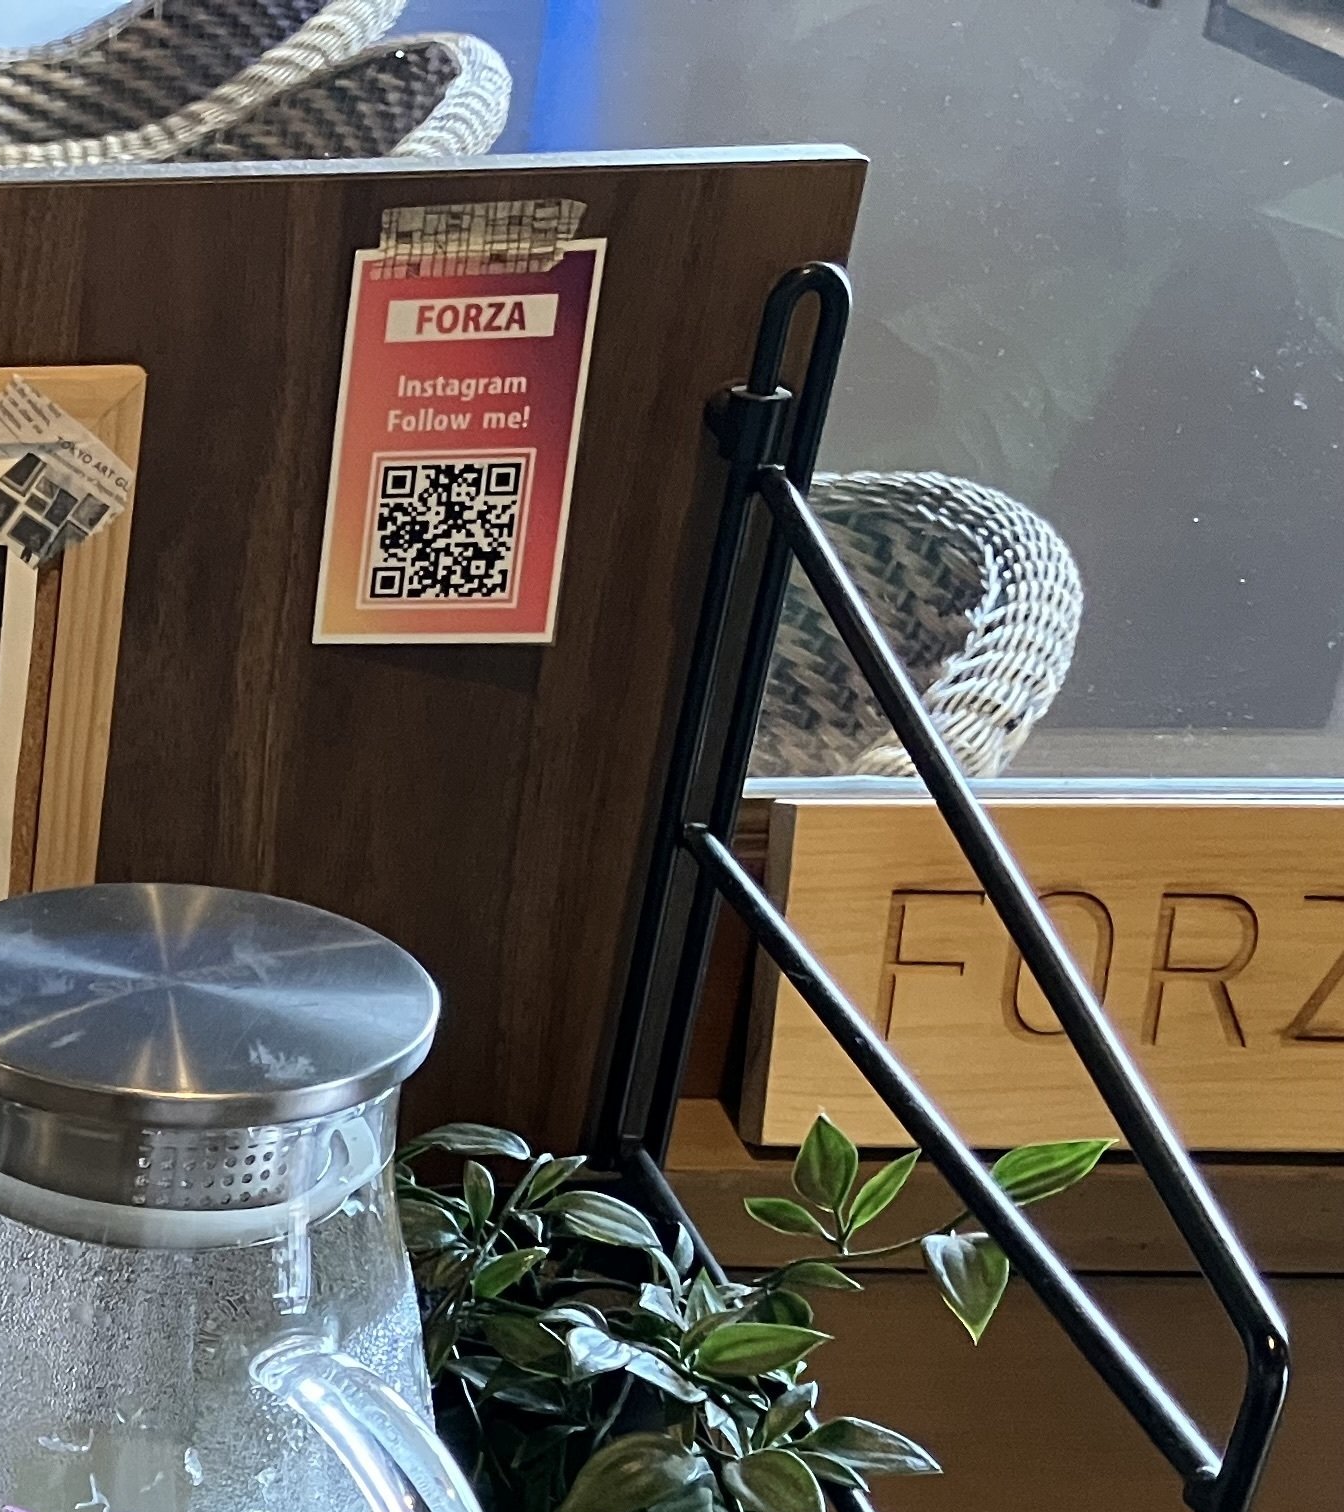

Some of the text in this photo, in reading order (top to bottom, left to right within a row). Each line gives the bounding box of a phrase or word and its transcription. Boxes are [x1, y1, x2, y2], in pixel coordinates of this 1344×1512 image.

[415, 301, 526, 335] FORZA
[398, 375, 527, 399] Instagram
[387, 405, 531, 432] Follow me!
